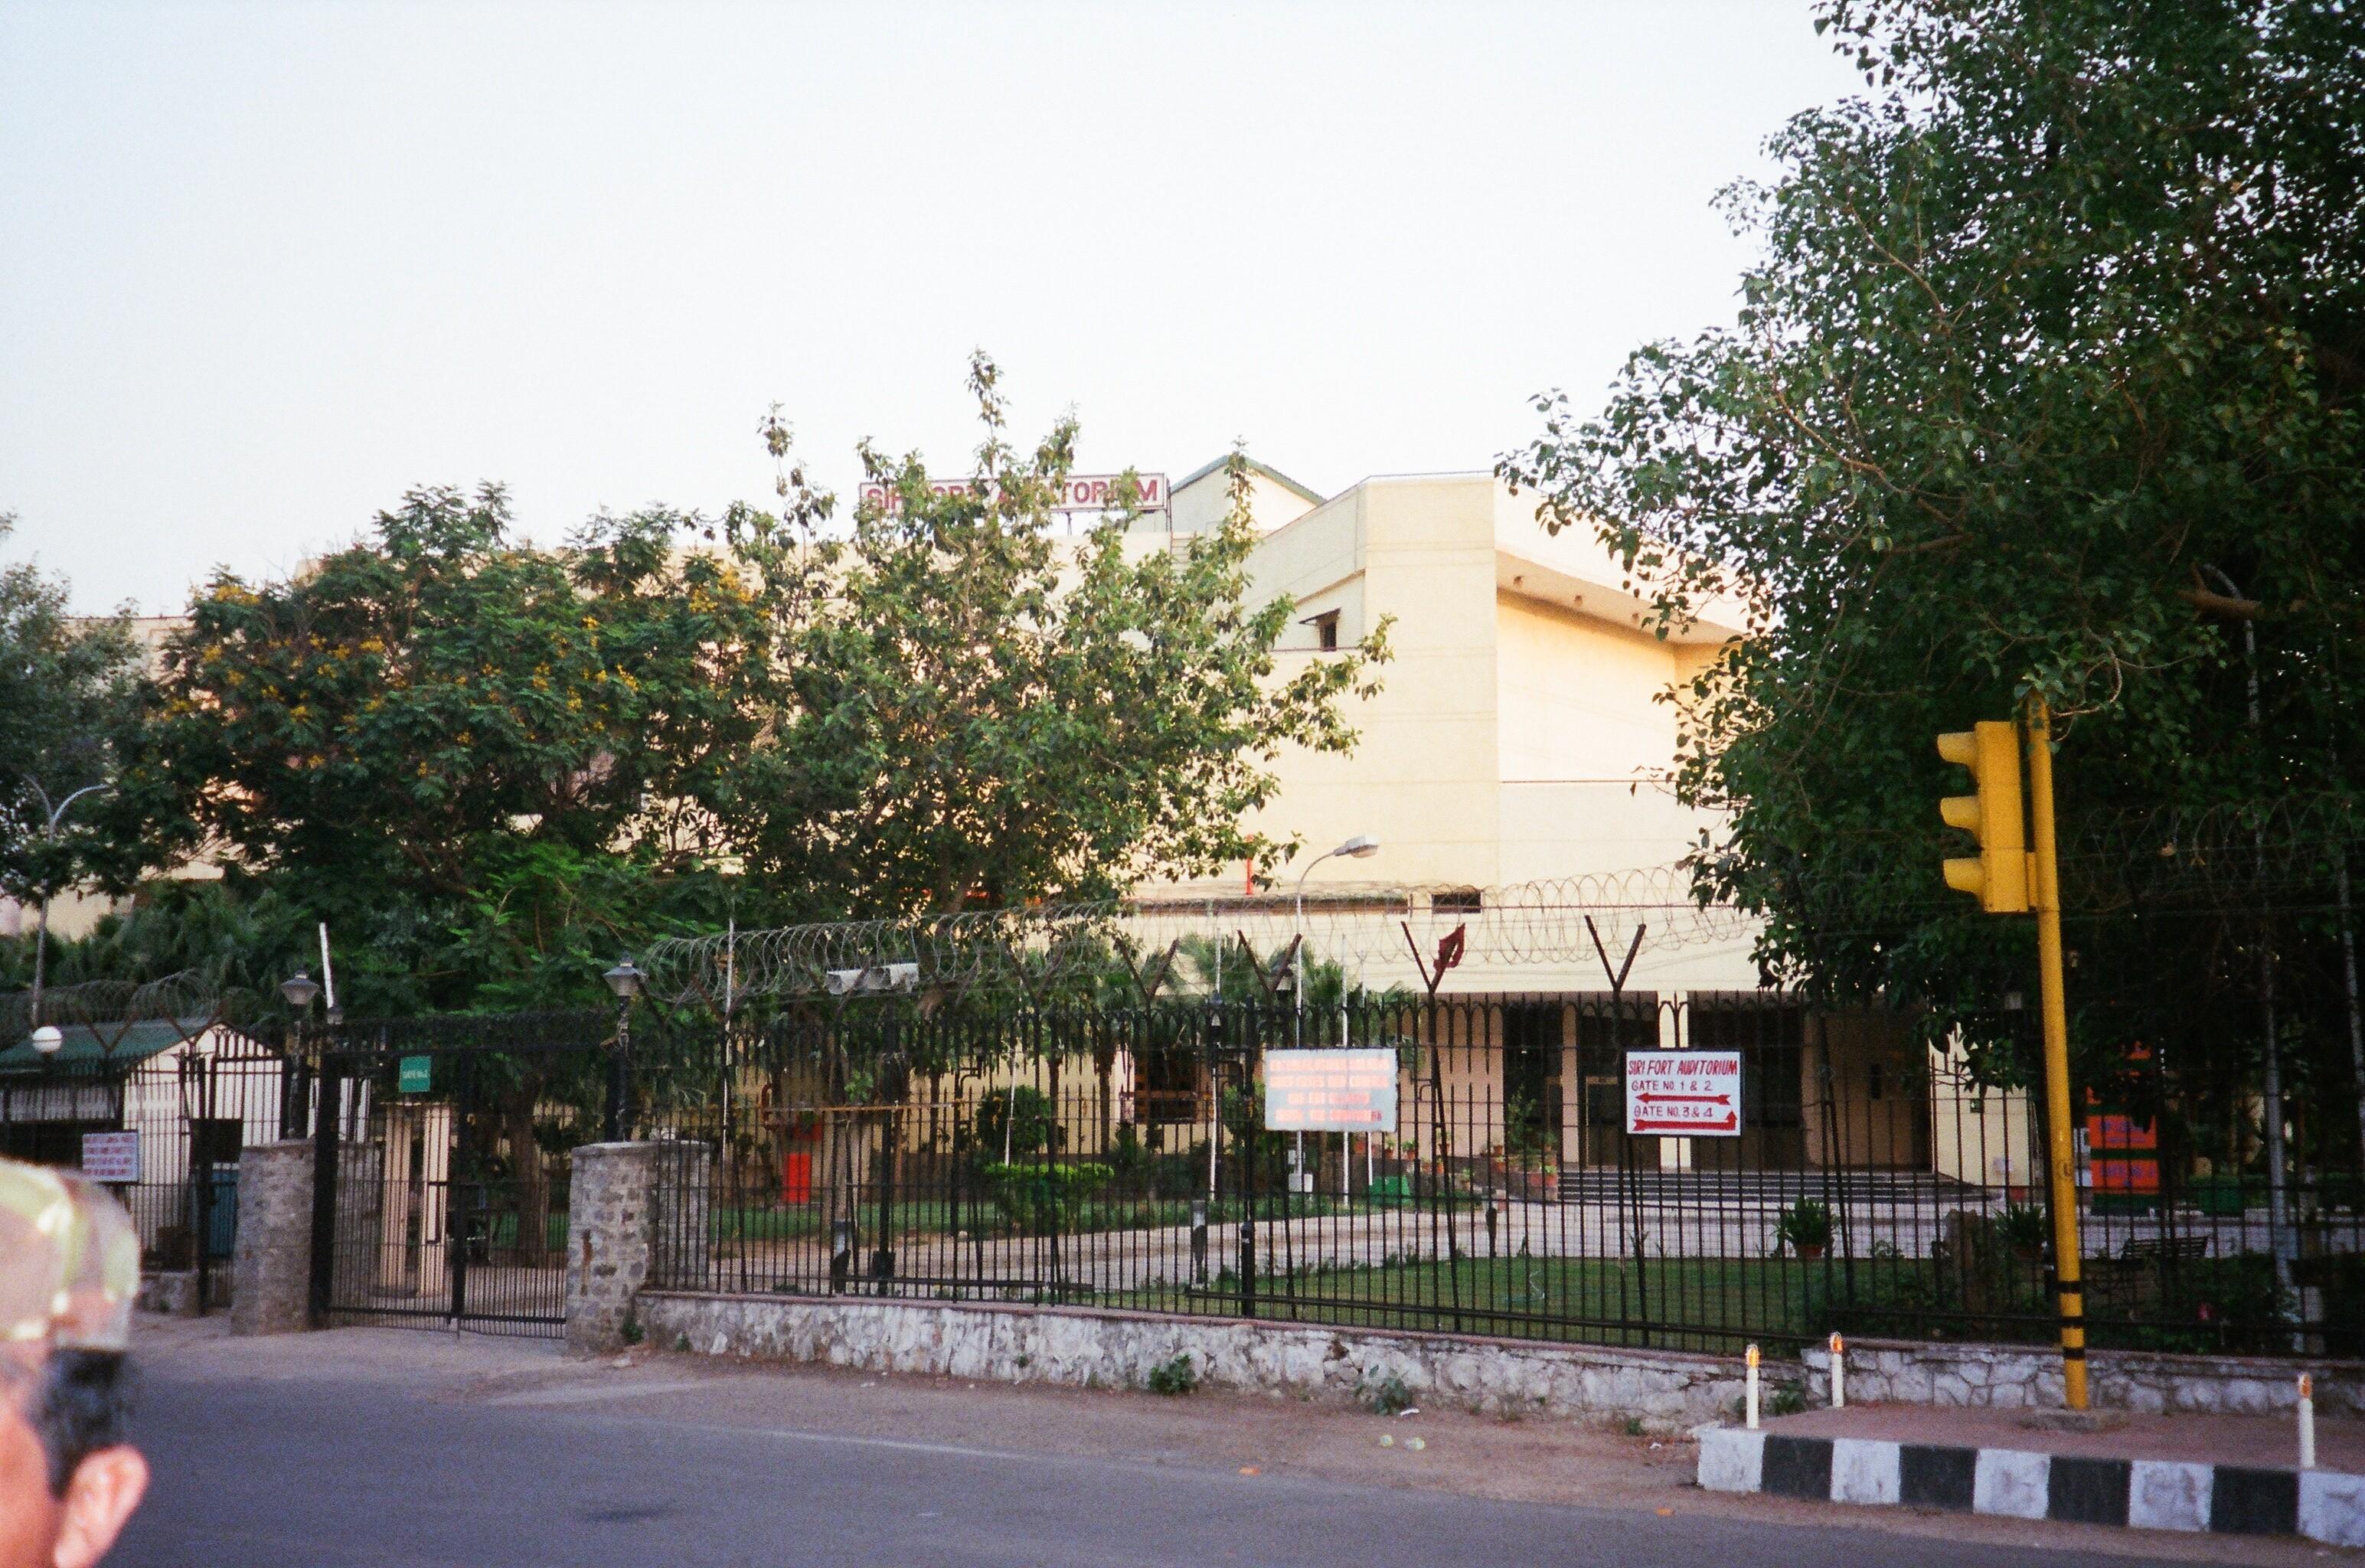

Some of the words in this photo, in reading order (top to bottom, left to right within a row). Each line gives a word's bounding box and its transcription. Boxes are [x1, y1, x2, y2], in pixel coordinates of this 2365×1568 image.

[867, 487, 910, 510] SIR
[1628, 1060, 1645, 1075] SIRI
[1647, 1060, 1674, 1075] FORT
[1677, 1060, 1737, 1075] AUDITORIUM
[1632, 1080, 1658, 1091] GATE
[1680, 1081, 1684, 1090] 1
[1690, 1080, 1697, 1091] &
[1704, 1080, 1713, 1091] 2
[1634, 1105, 1662, 1117] GATE
[1683, 1106, 1689, 1117] 3
[1691, 1106, 1700, 1117] &
[1703, 1107, 1713, 1117] 4
